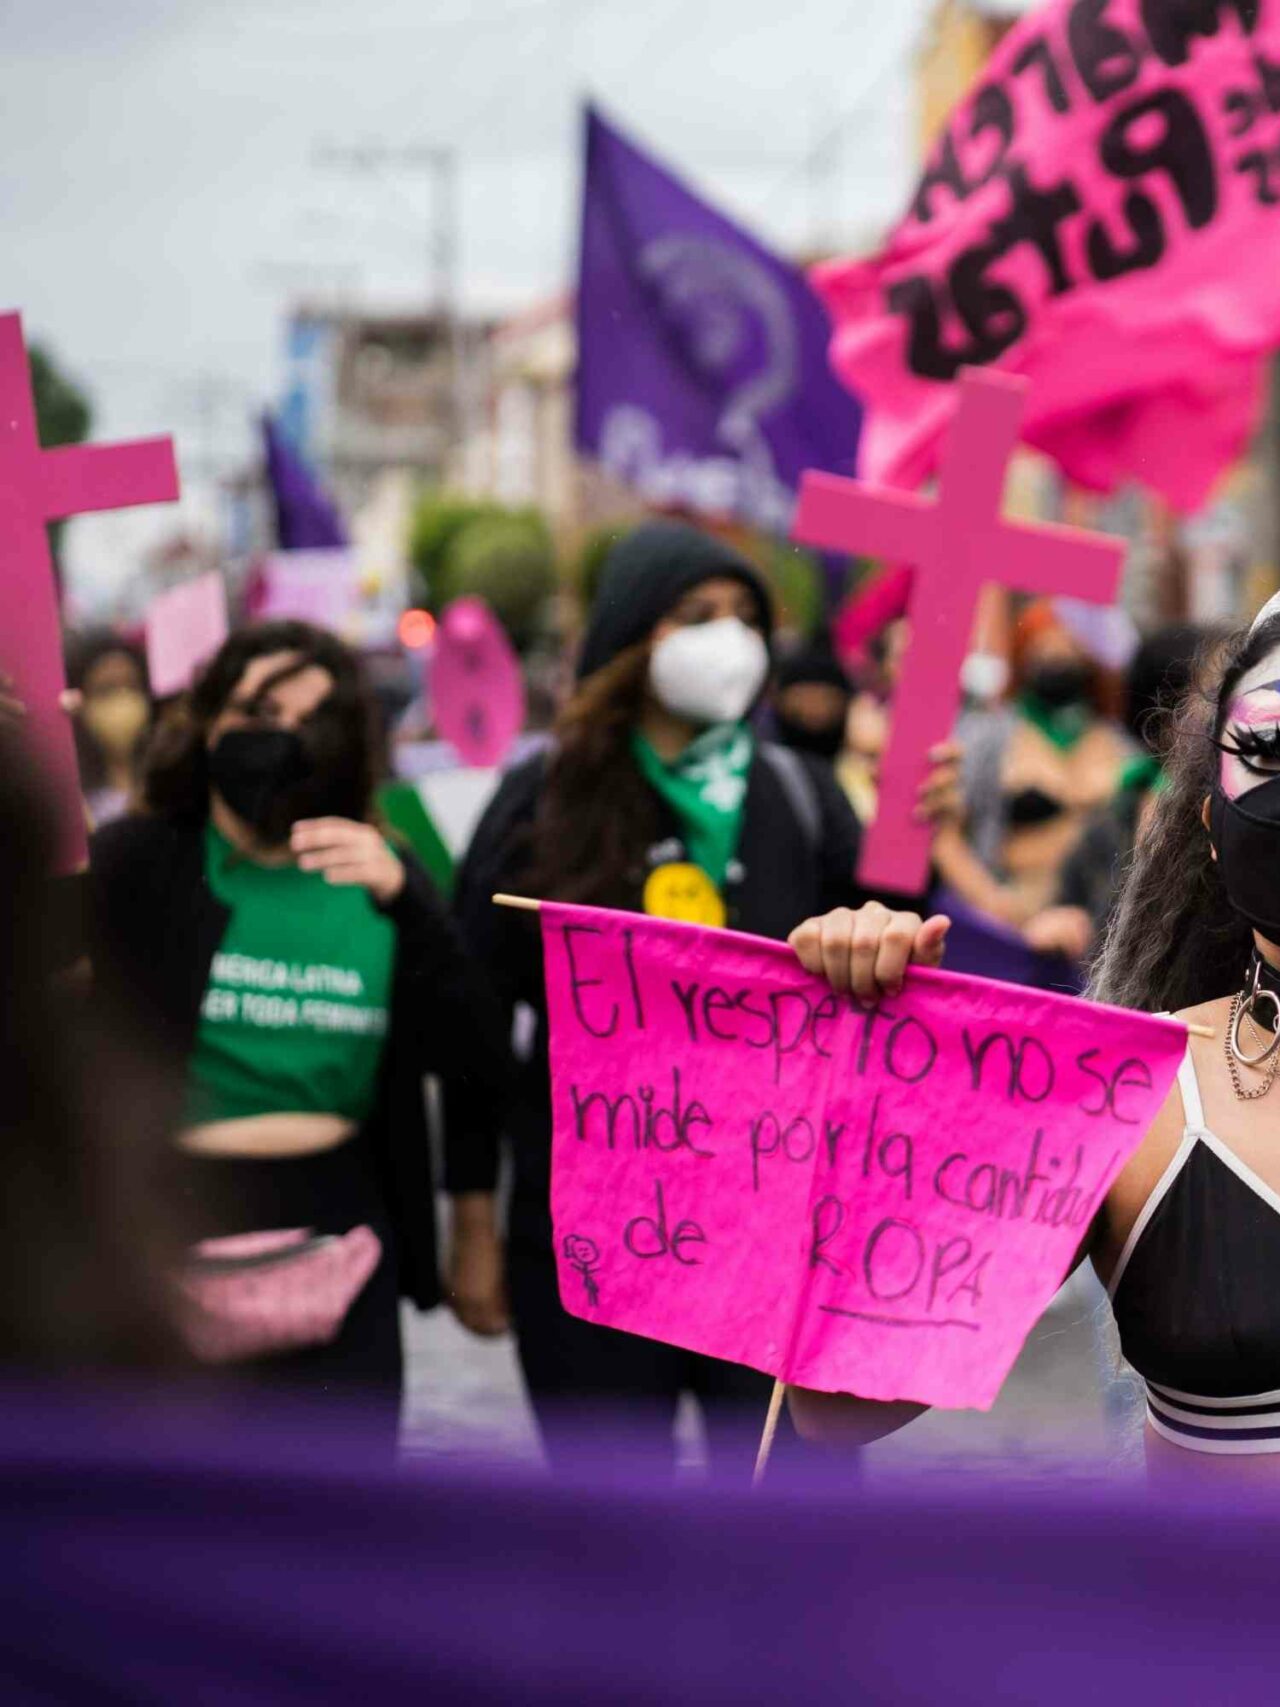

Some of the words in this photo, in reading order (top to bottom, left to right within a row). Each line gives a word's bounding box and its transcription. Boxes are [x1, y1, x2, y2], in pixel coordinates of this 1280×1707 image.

[563, 924, 645, 1038] El
[961, 1028, 1055, 1103] no
[1076, 1048, 1153, 1125] se
[570, 1067, 717, 1160] mide
[751, 1110, 849, 1194] por
[624, 1178, 708, 1266] de
[809, 1194, 993, 1313] ROPA
